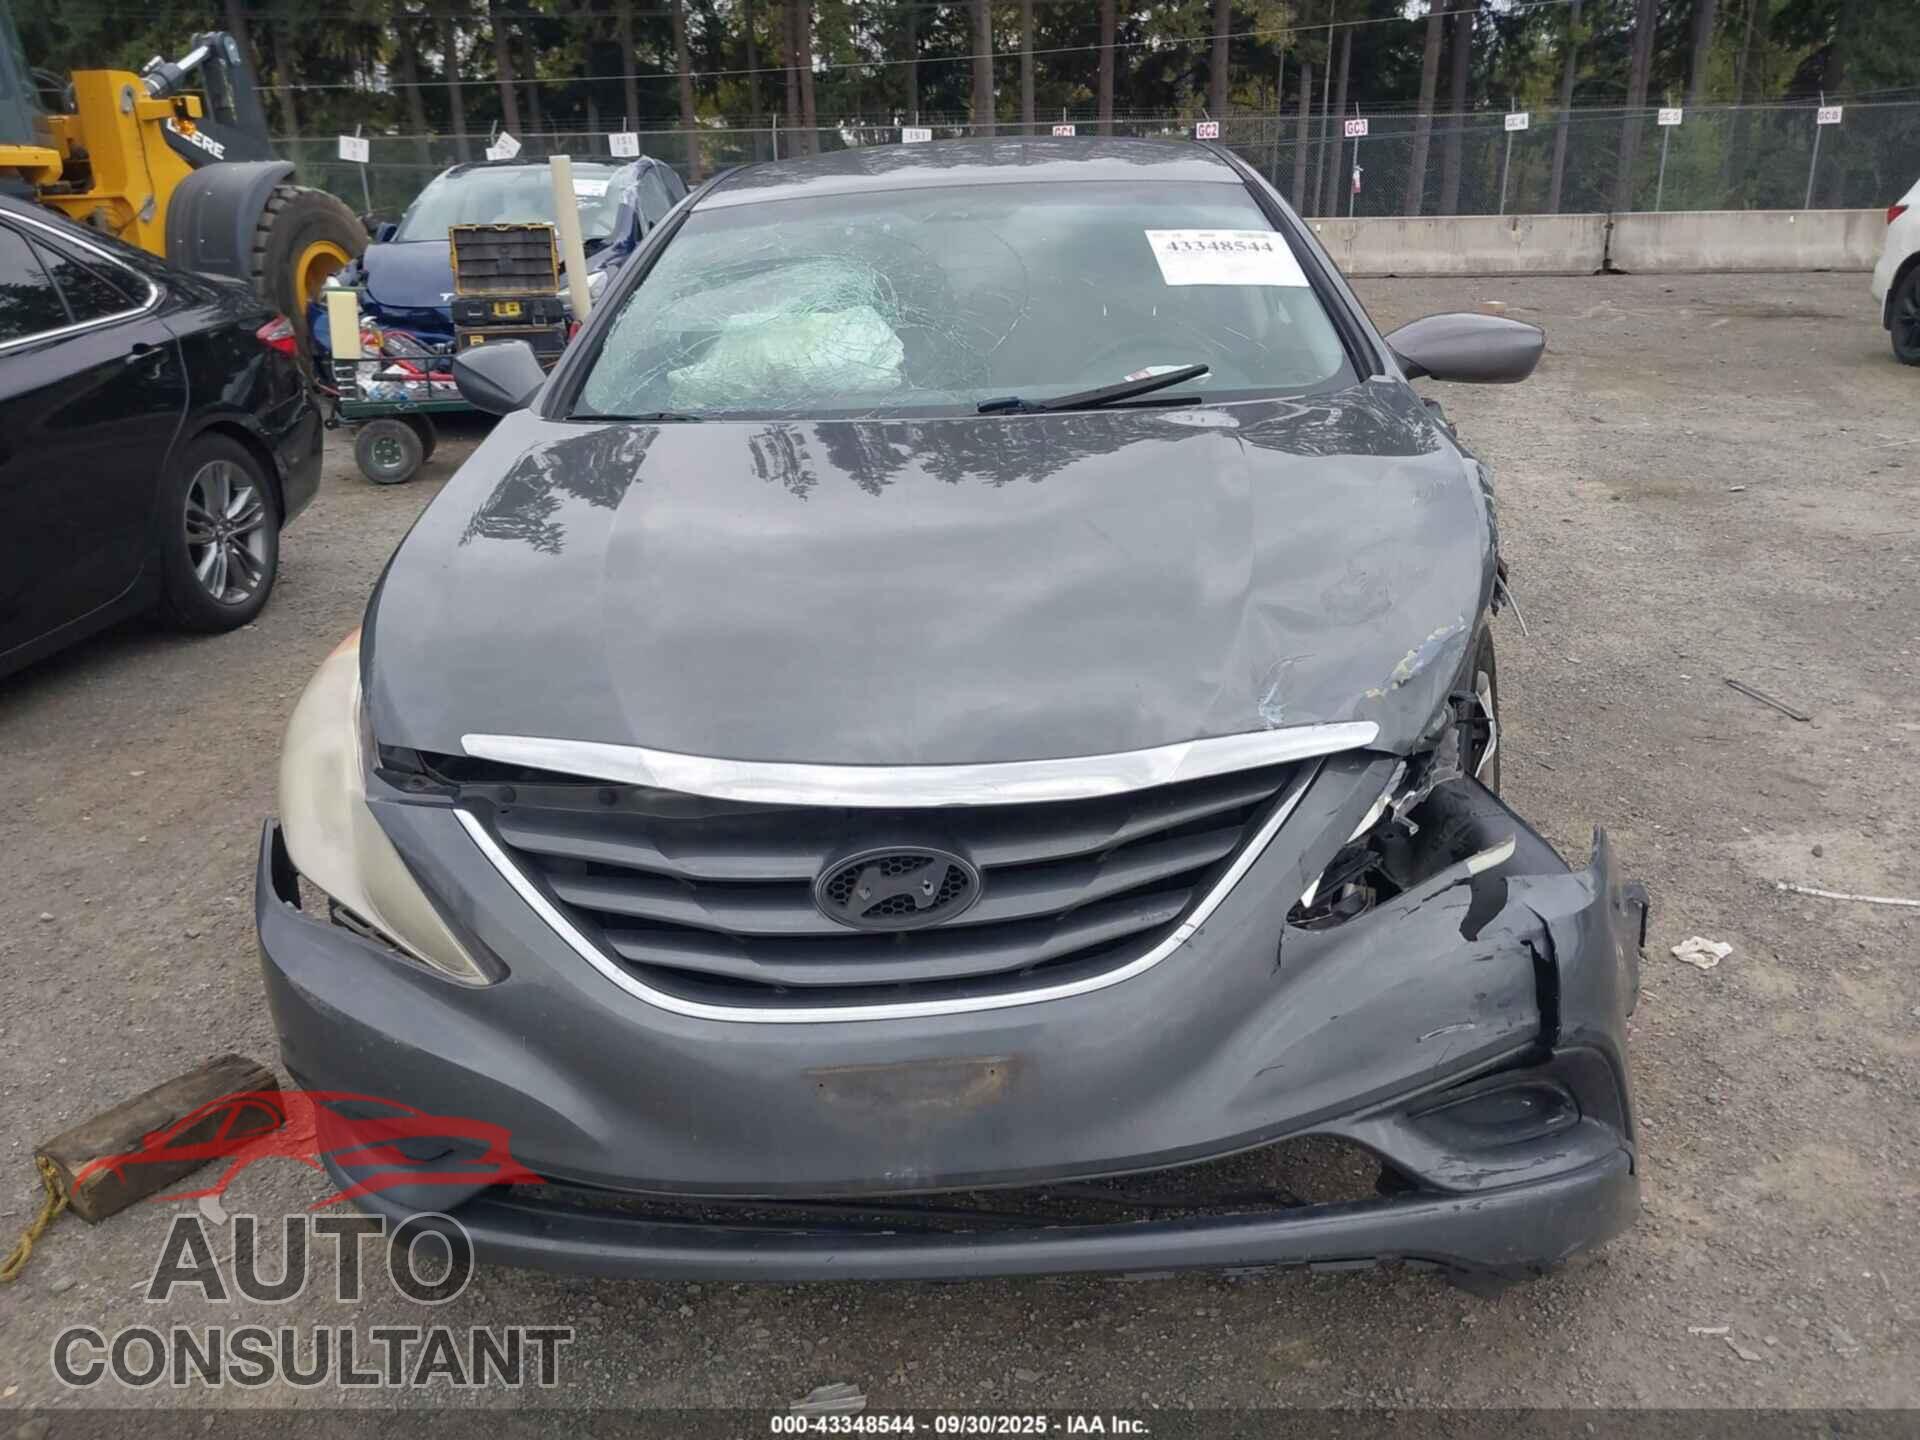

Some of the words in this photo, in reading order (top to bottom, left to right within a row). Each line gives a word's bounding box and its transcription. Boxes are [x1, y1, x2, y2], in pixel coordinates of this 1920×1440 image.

[1198, 124, 1217, 137] GC2
[1346, 121, 1367, 134] GC3
[1166, 240, 1273, 253] 43348544
